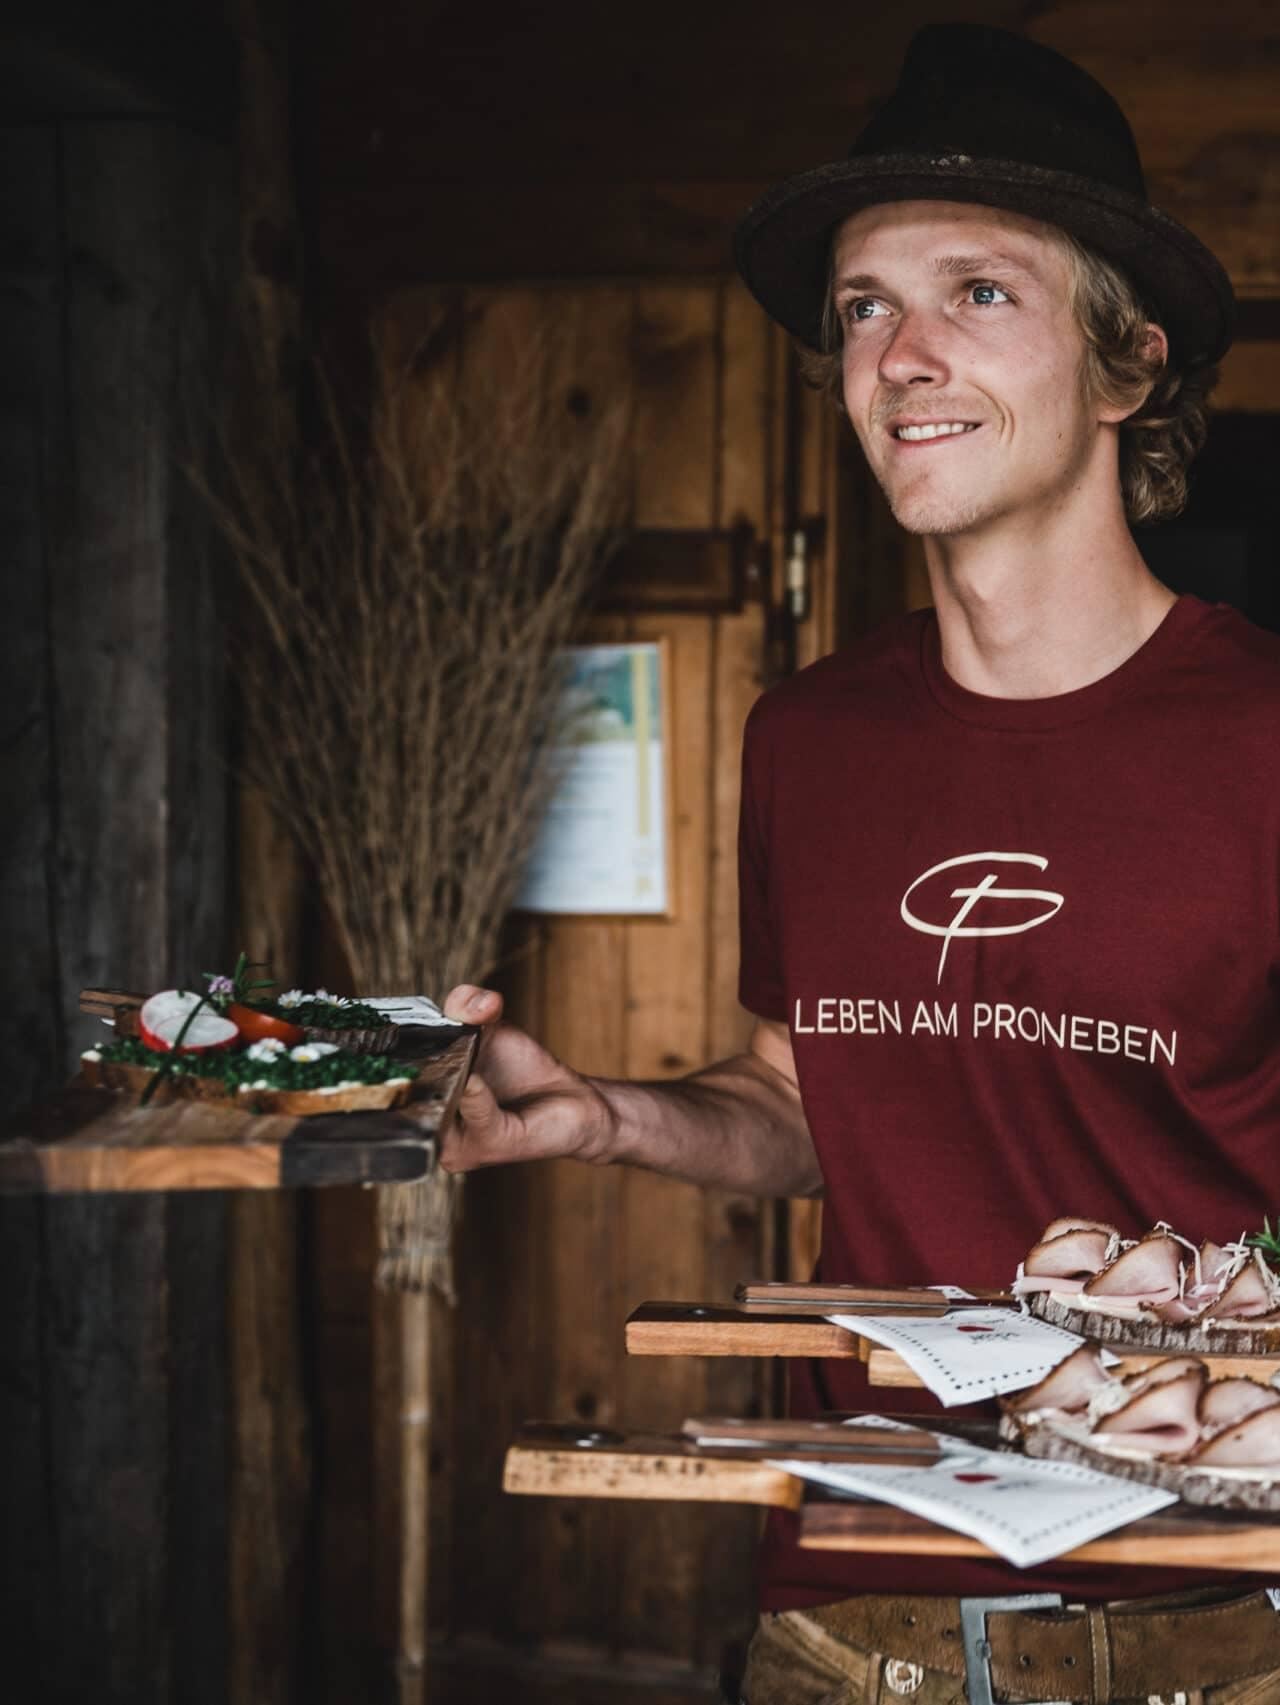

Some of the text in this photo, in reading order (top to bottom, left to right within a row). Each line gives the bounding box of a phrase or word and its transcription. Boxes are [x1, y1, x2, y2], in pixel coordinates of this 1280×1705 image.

[794, 997, 1178, 1067] LEBEN AM PRONEBEN
